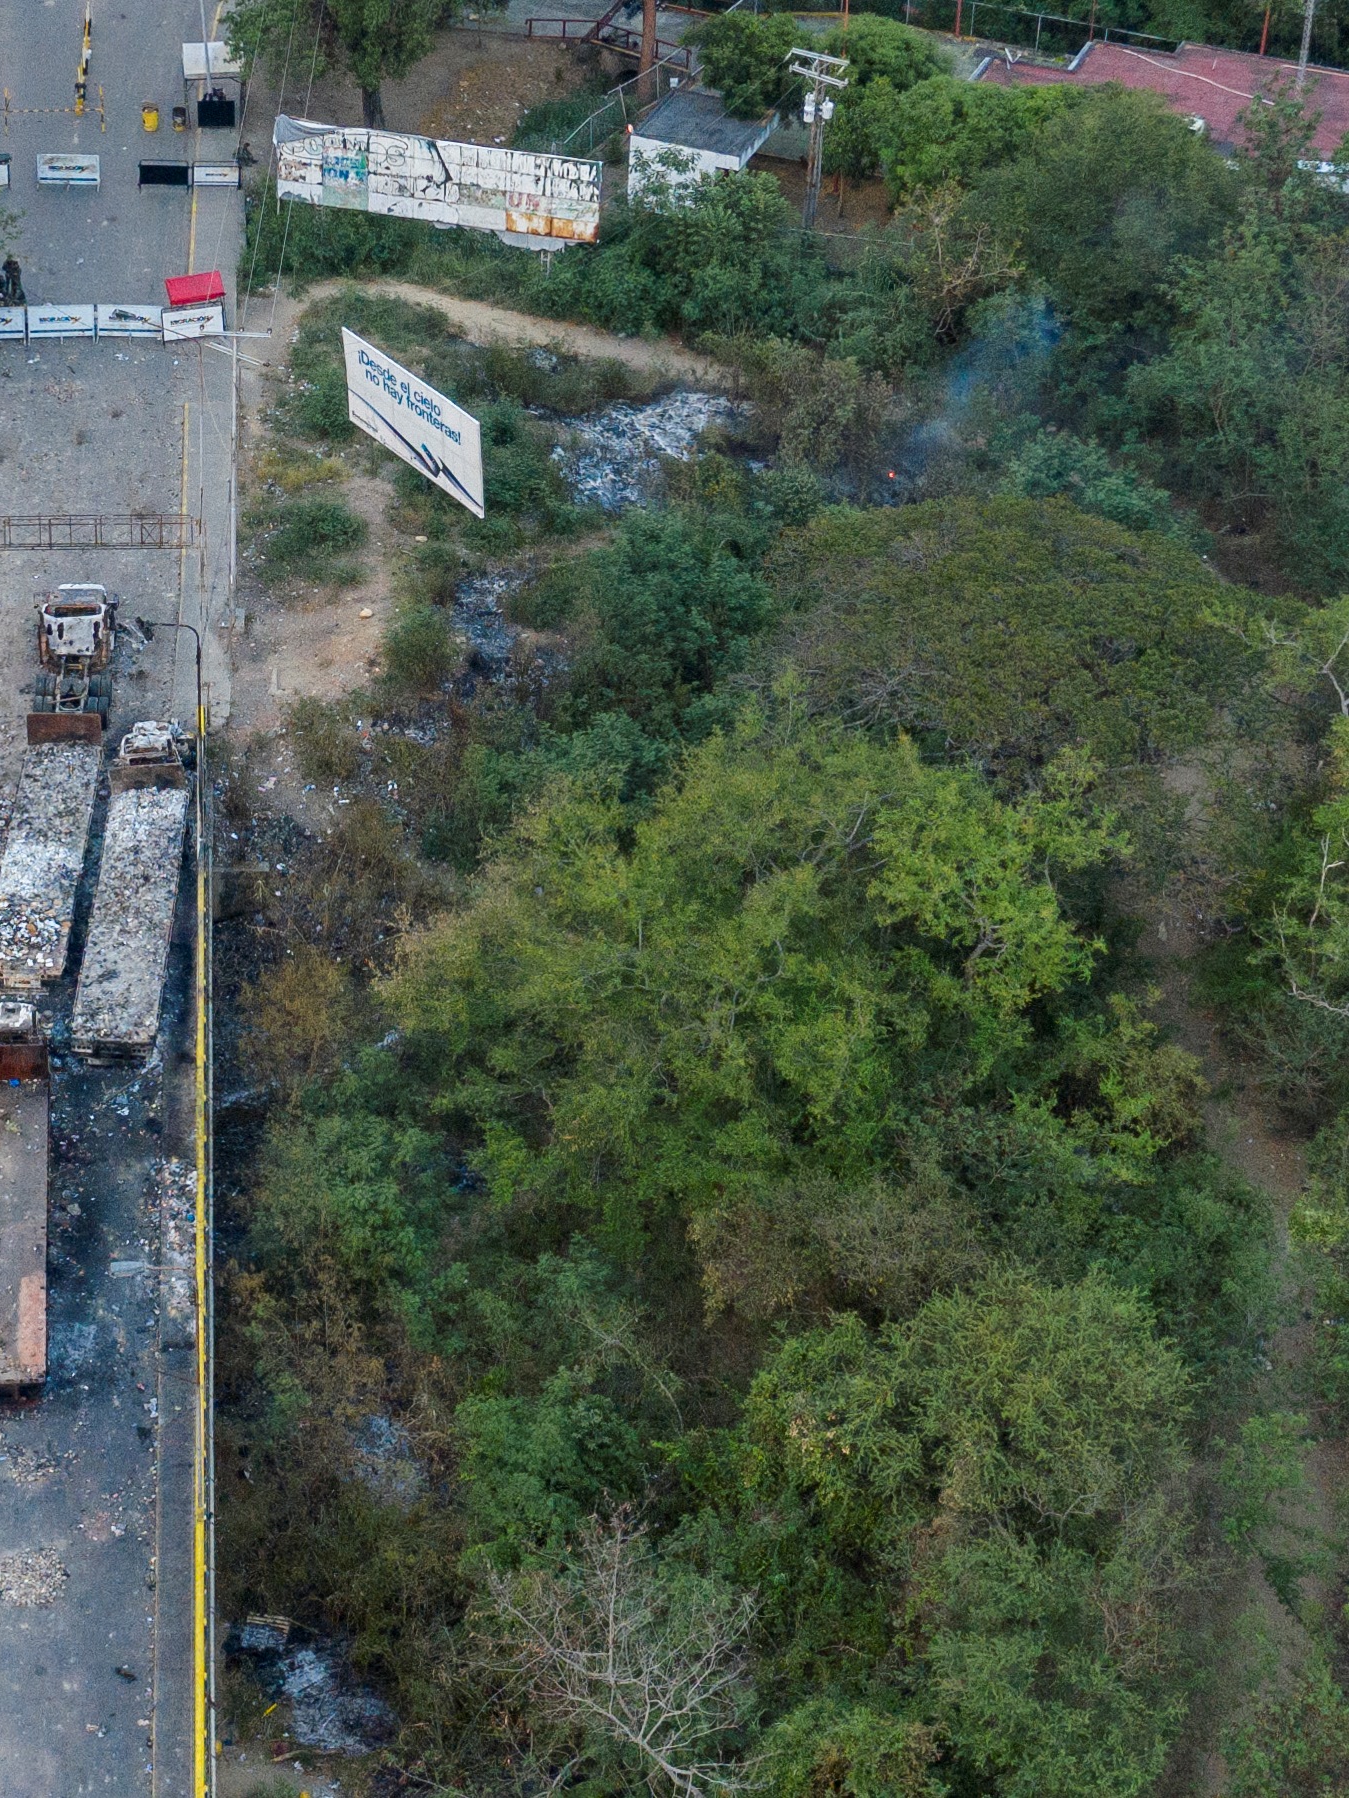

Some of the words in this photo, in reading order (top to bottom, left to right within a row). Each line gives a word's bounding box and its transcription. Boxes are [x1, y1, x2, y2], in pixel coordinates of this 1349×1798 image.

[357, 349, 397, 386] ¡Desde
[400, 381, 410, 395] el
[413, 391, 441, 416] cielo
[365, 368, 380, 386] no
[382, 378, 403, 405] hay
[406, 395, 461, 445] fronteras!
